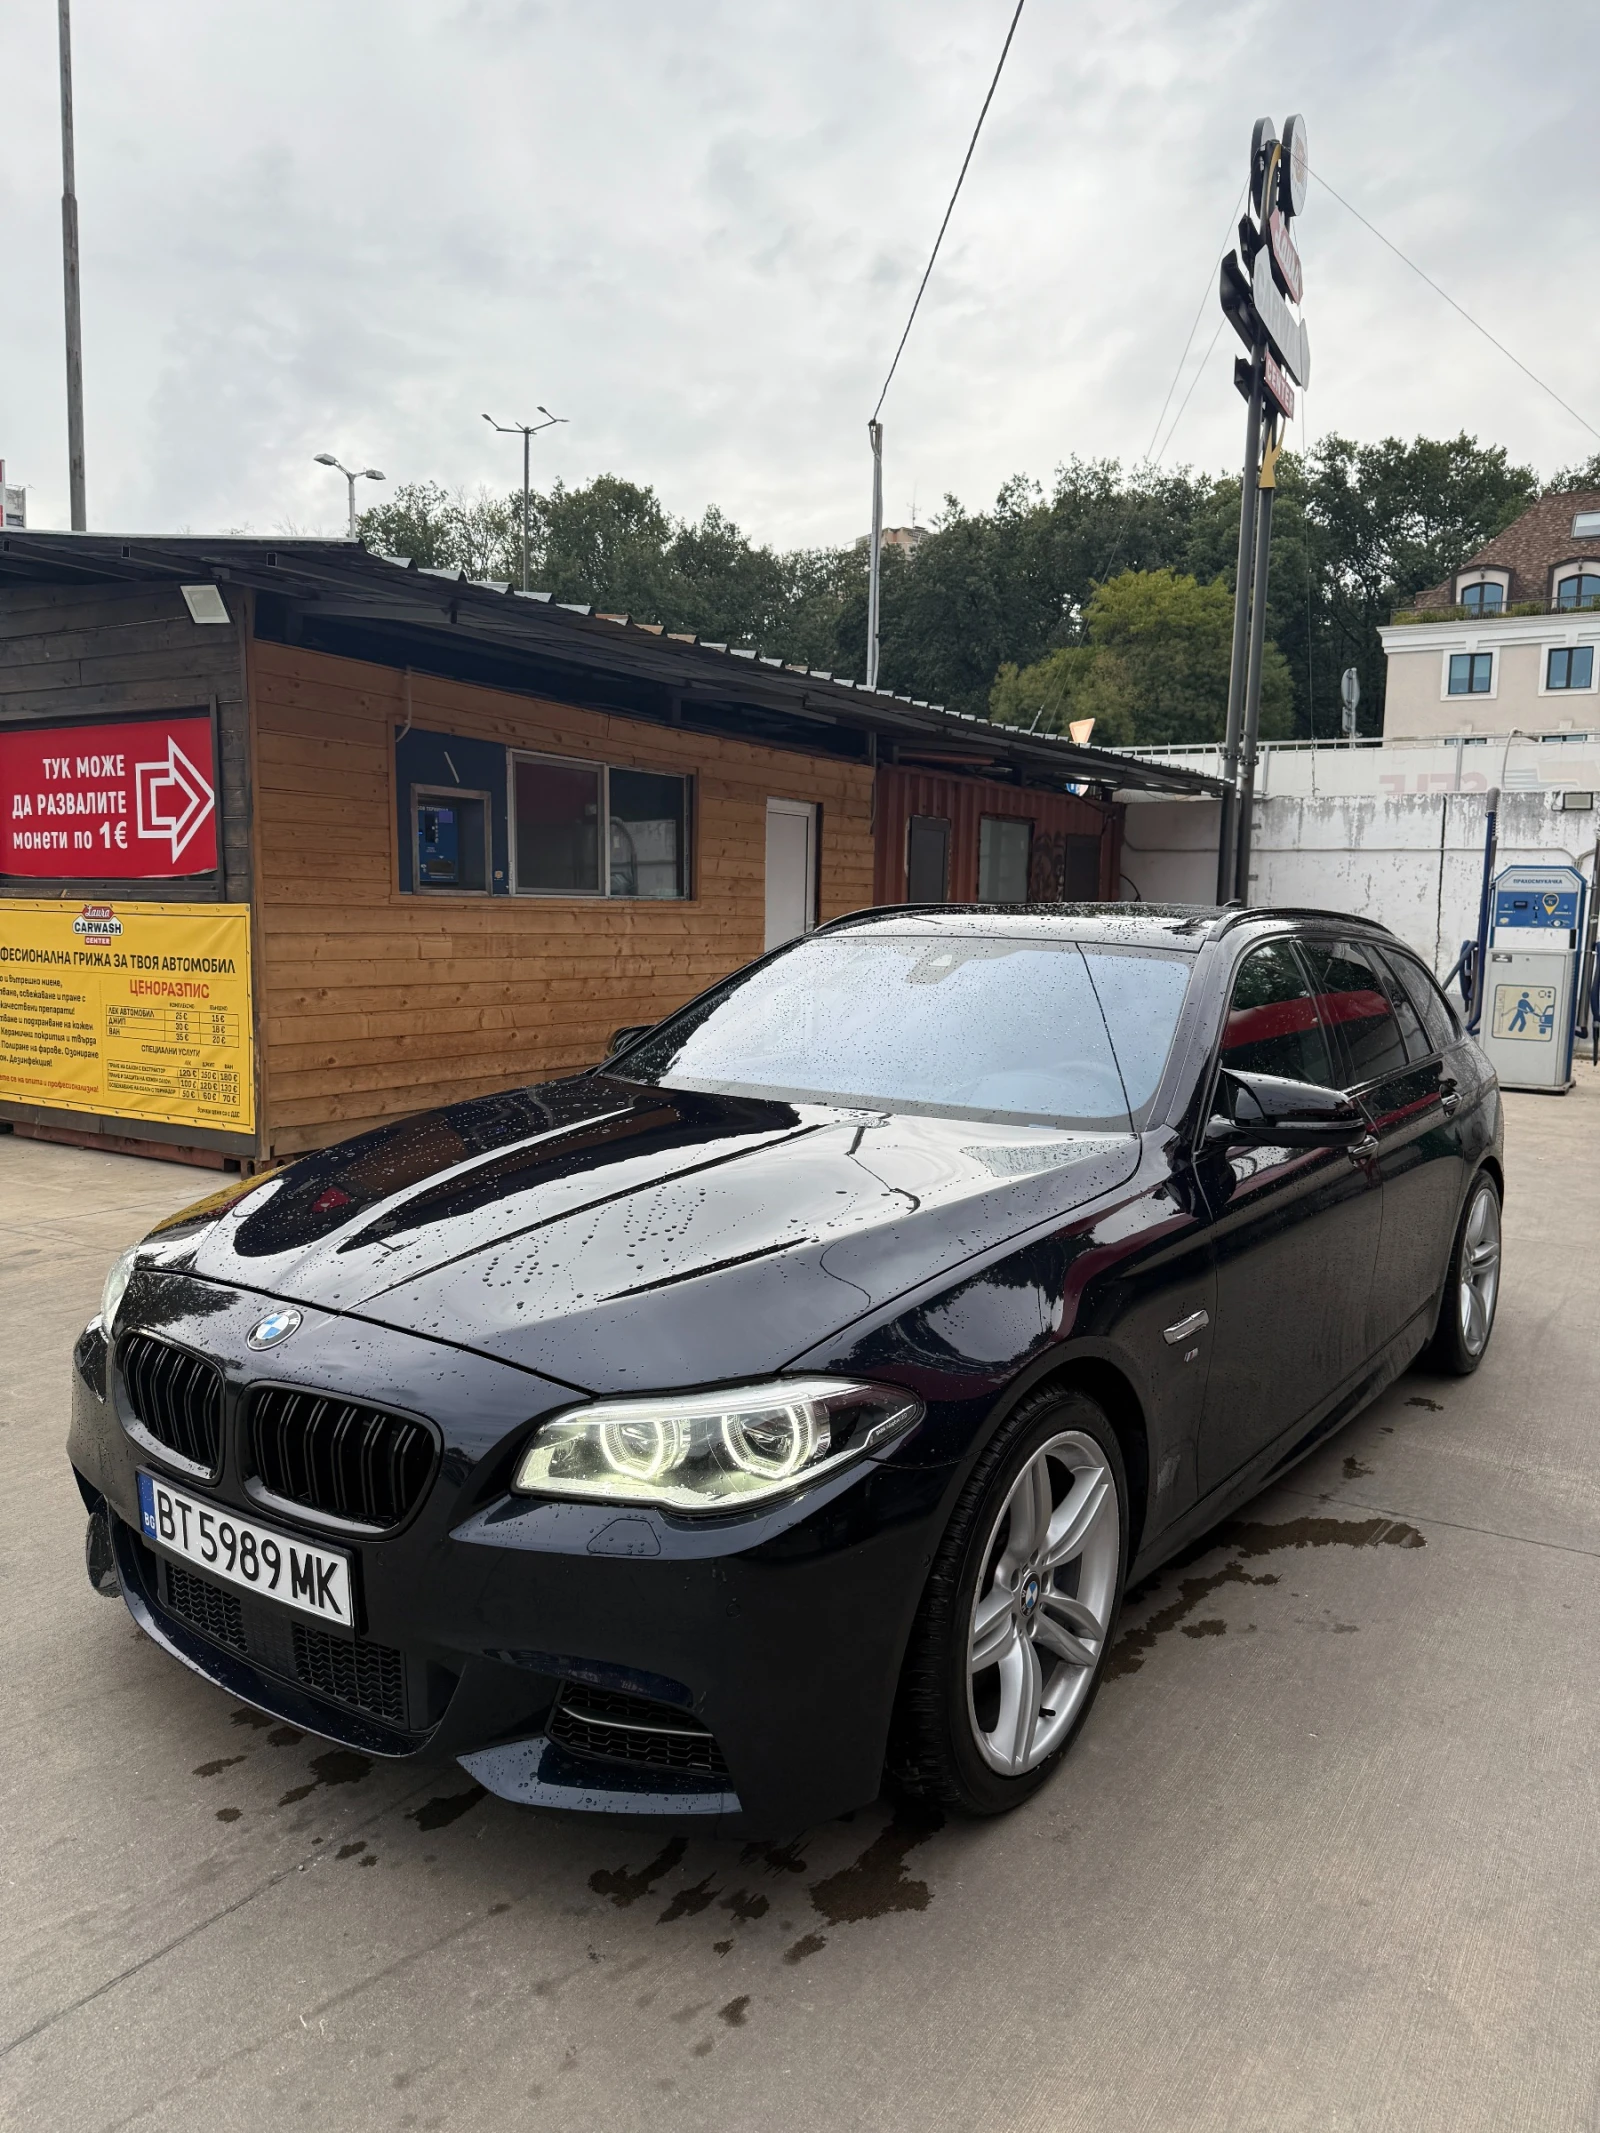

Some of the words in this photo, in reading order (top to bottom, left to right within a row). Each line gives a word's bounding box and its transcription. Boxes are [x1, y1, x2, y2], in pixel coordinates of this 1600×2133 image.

[1267, 360, 1293, 416] CENTER
[42, 757, 72, 780] ТУК
[76, 754, 126, 779] МОЖЕ
[12, 793, 33, 820] ДА
[37, 790, 127, 816] РАЗВАЛИТЕ
[13, 830, 68, 850] монети
[74, 830, 93, 850] по
[85, 905, 111, 918] Laura
[74, 922, 122, 934] CARWASH
[85, 937, 110, 945] CENTER
[0, 946, 71, 965] ФЕСИОНАЛНА
[73, 951, 112, 968] ГРИЖА
[113, 953, 128, 969] ЗА
[130, 954, 159, 971] ТВОЯ
[161, 956, 236, 974] АВТОМОБИЛ
[9, 975, 41, 986] вътрешно
[129, 979, 210, 999] ЦЕНОРАЗПИС
[62, 994, 81, 1004] пране
[108, 1006, 119, 1015] ЛЕК
[120, 1007, 155, 1018] АВТОМОБИЛ
[64, 1020, 71, 1029] на
[108, 1017, 127, 1026] ДЖИП
[34, 1030, 66, 1042] покрития
[71, 1034, 97, 1047] твърда
[108, 1027, 120, 1036] ВАН
[1, 1040, 30, 1052] Полиране
[30, 1044, 37, 1052] на
[38, 1044, 64, 1056] фарове.
[64, 1047, 99, 1059] Озониране
[141, 1044, 178, 1056] СПЕЦИАЛНИ
[178, 1048, 201, 1058] УСЛУГИ
[9, 1054, 53, 1068] Дезинфекция!
[143, 1512, 156, 1530] BG
[199, 1510, 282, 1591] 5989
